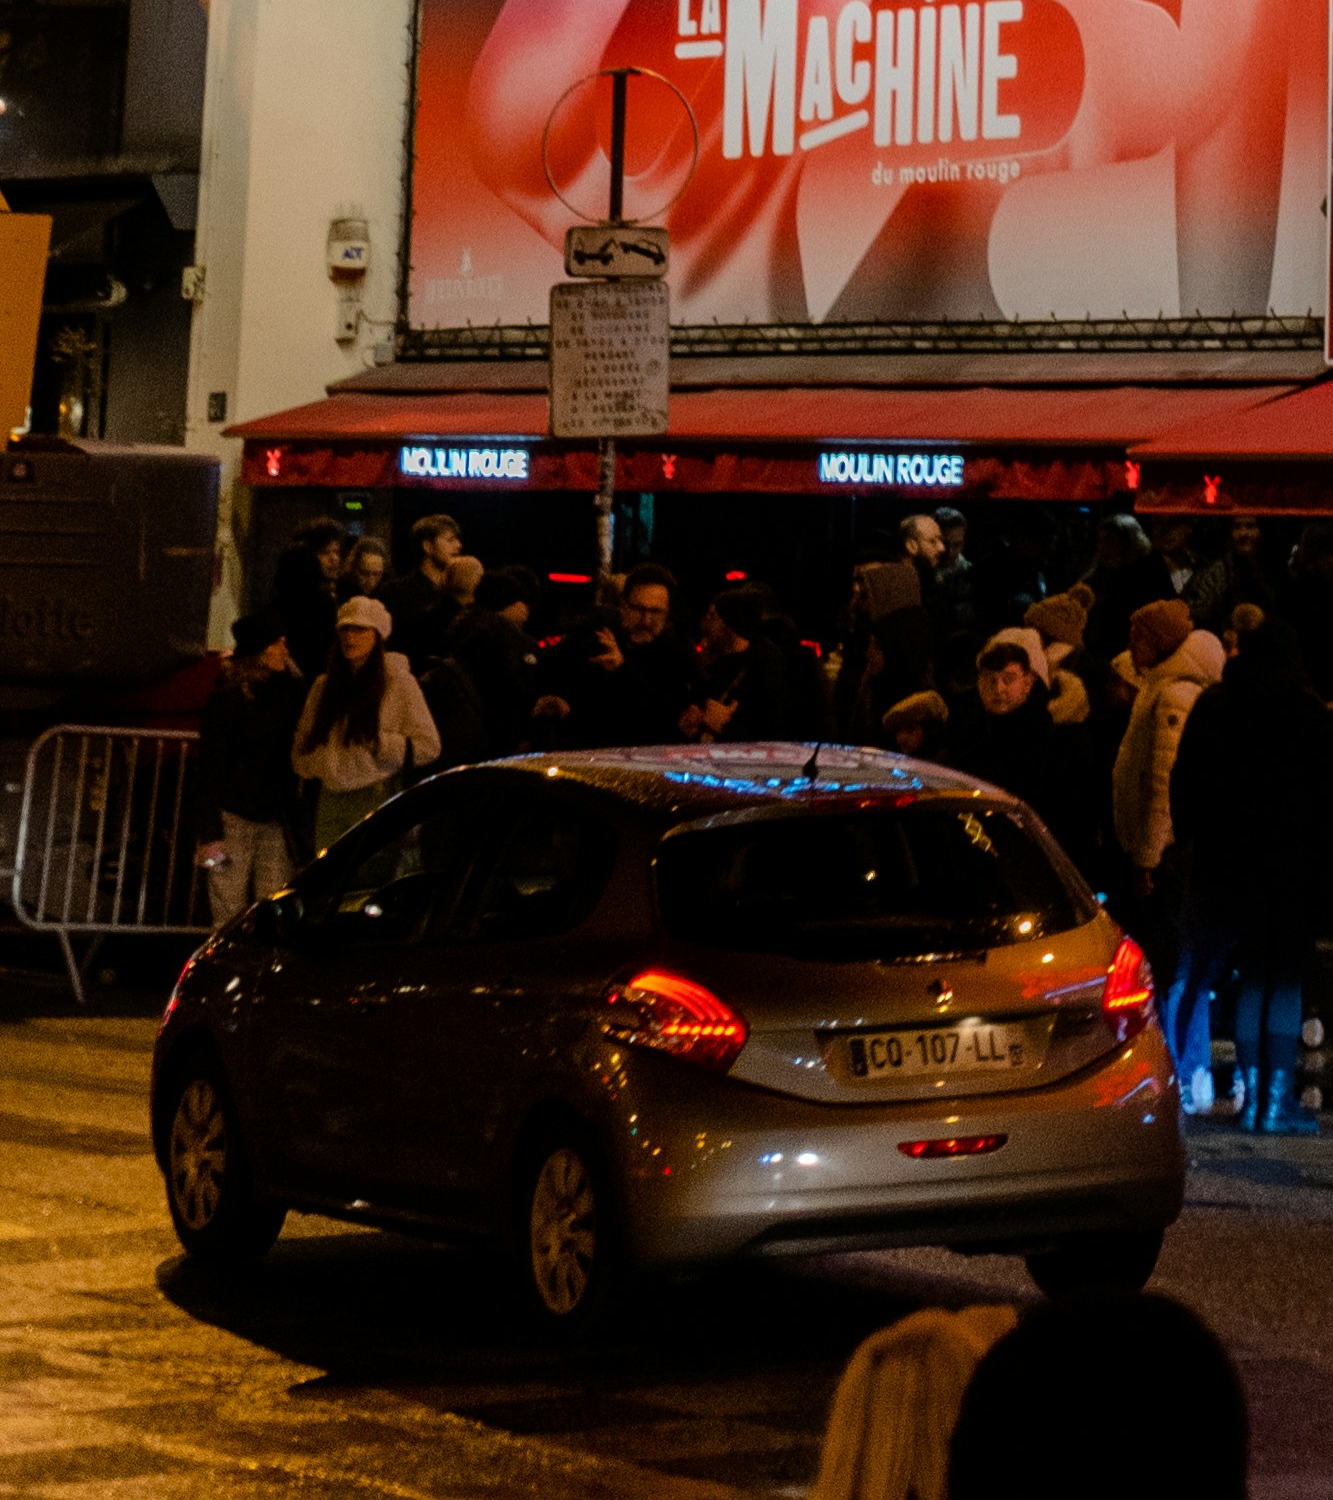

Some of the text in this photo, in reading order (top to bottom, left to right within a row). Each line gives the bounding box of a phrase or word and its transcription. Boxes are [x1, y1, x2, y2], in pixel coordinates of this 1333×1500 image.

[871, 158, 1021, 187] du moulin rouge
[819, 452, 964, 486] MOULIN ROUGE
